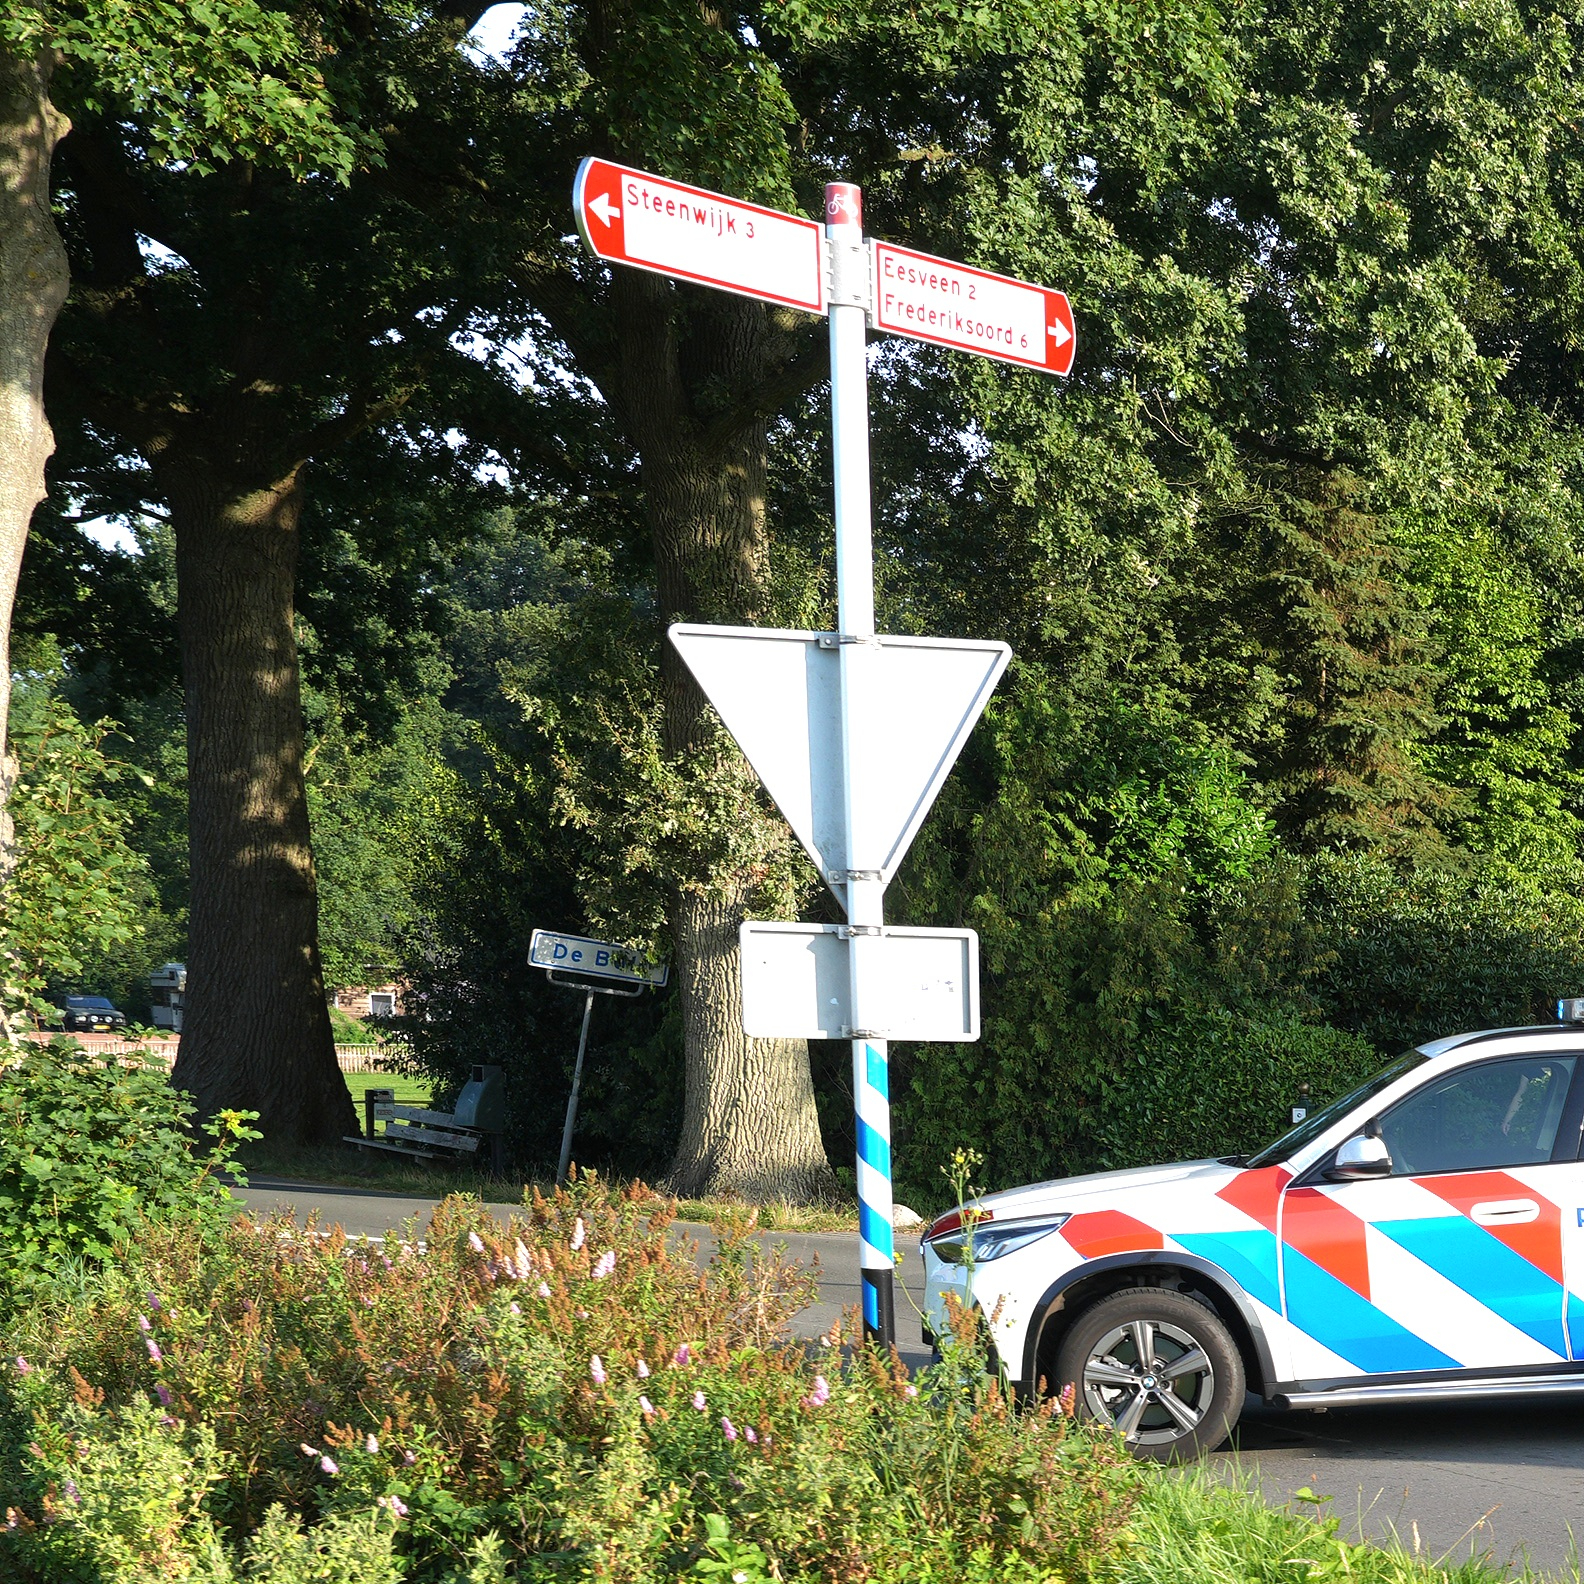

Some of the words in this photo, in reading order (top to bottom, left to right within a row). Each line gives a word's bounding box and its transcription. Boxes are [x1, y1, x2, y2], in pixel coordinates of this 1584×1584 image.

[627, 183, 737, 237] Steenwijk
[745, 220, 756, 239] 3
[884, 257, 960, 297] Eesveen
[968, 284, 977, 301] 2
[884, 293, 1014, 346] Frederiksoord
[1019, 332, 1029, 349] 6
[553, 943, 584, 963] De
